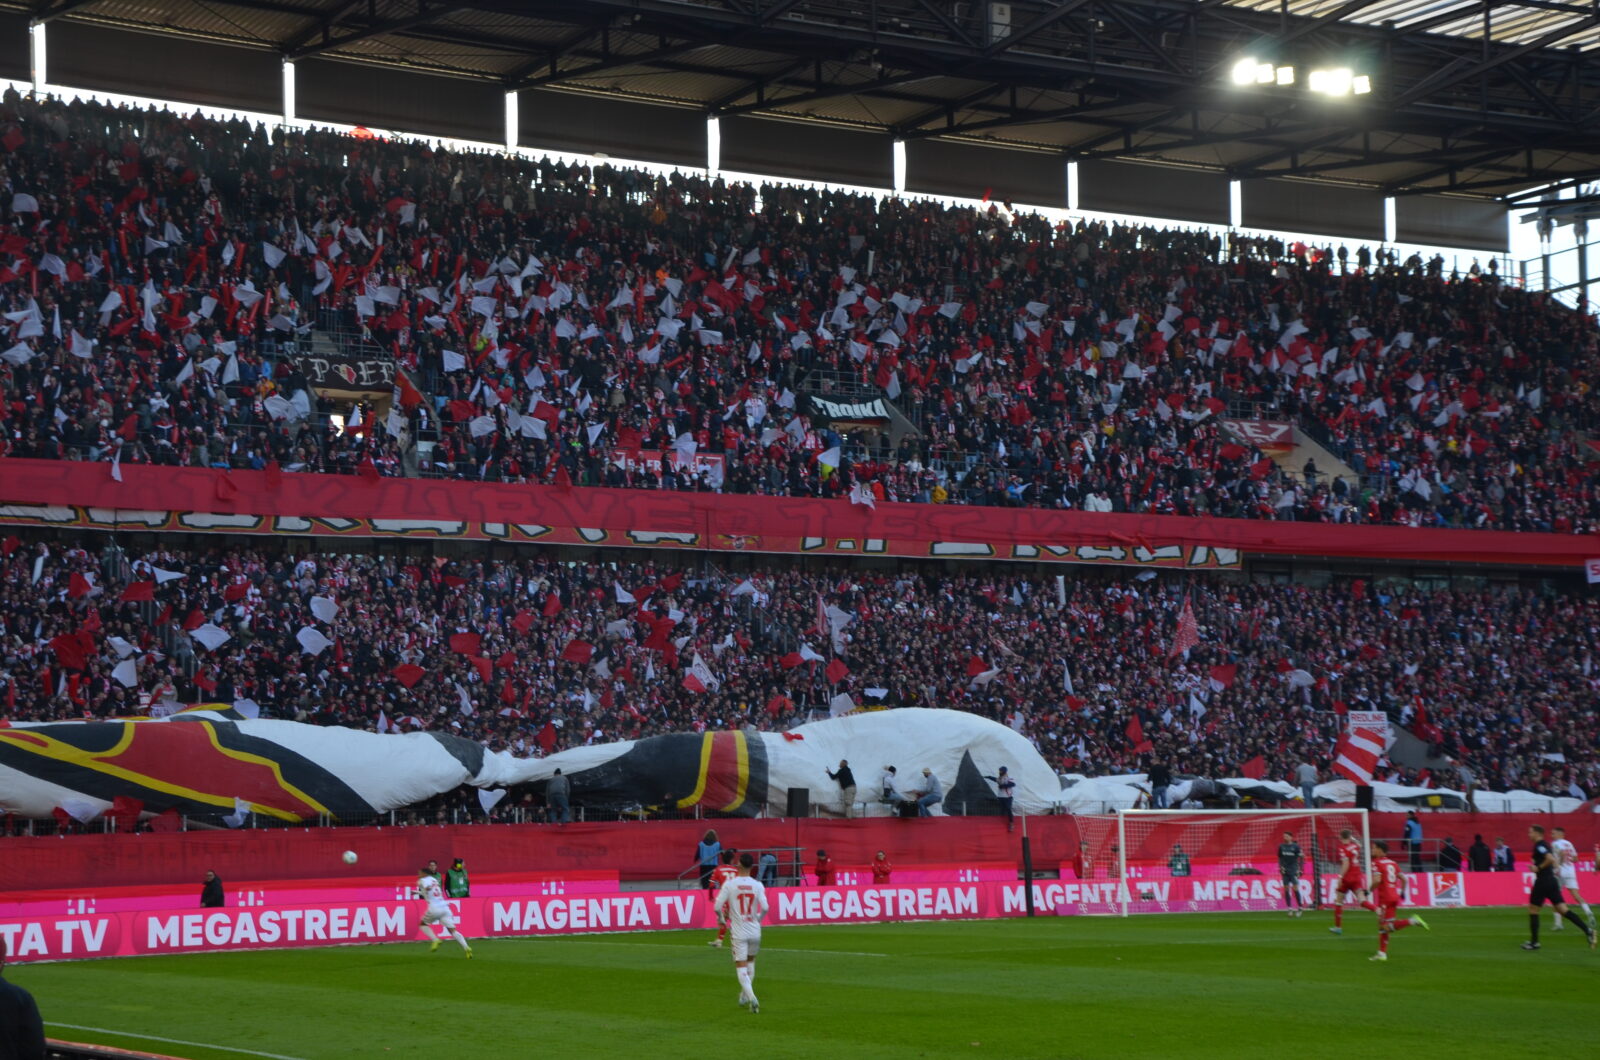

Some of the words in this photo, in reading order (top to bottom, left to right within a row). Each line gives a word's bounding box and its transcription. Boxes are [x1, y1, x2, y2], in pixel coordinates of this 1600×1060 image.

[1386, 864, 1397, 883] 8
[493, 897, 651, 932] MAGENTA
[655, 895, 695, 925] TV
[737, 893, 755, 916] 17
[778, 887, 978, 921] MEGASTREAM
[55, 919, 109, 954] TV
[147, 906, 406, 948] MEGASTREAM
